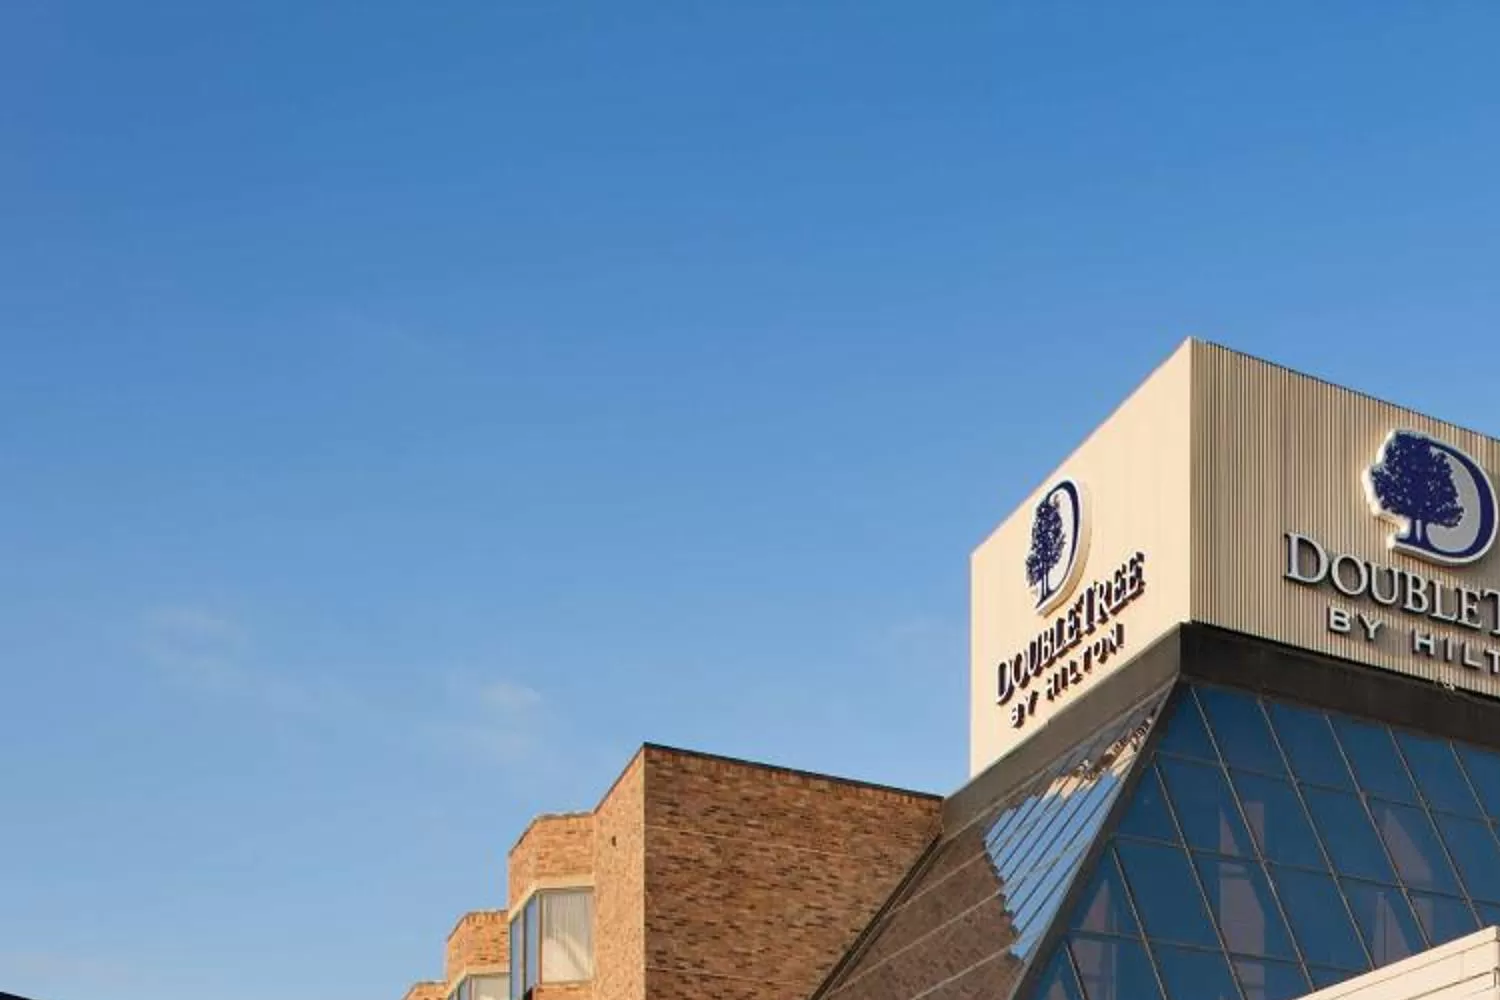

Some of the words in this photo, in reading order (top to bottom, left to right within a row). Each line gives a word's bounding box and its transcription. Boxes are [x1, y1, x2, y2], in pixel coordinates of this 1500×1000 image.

[1328, 605, 1383, 641] BY
[1010, 690, 1038, 729] BY
[1046, 623, 1125, 701] HILTON
